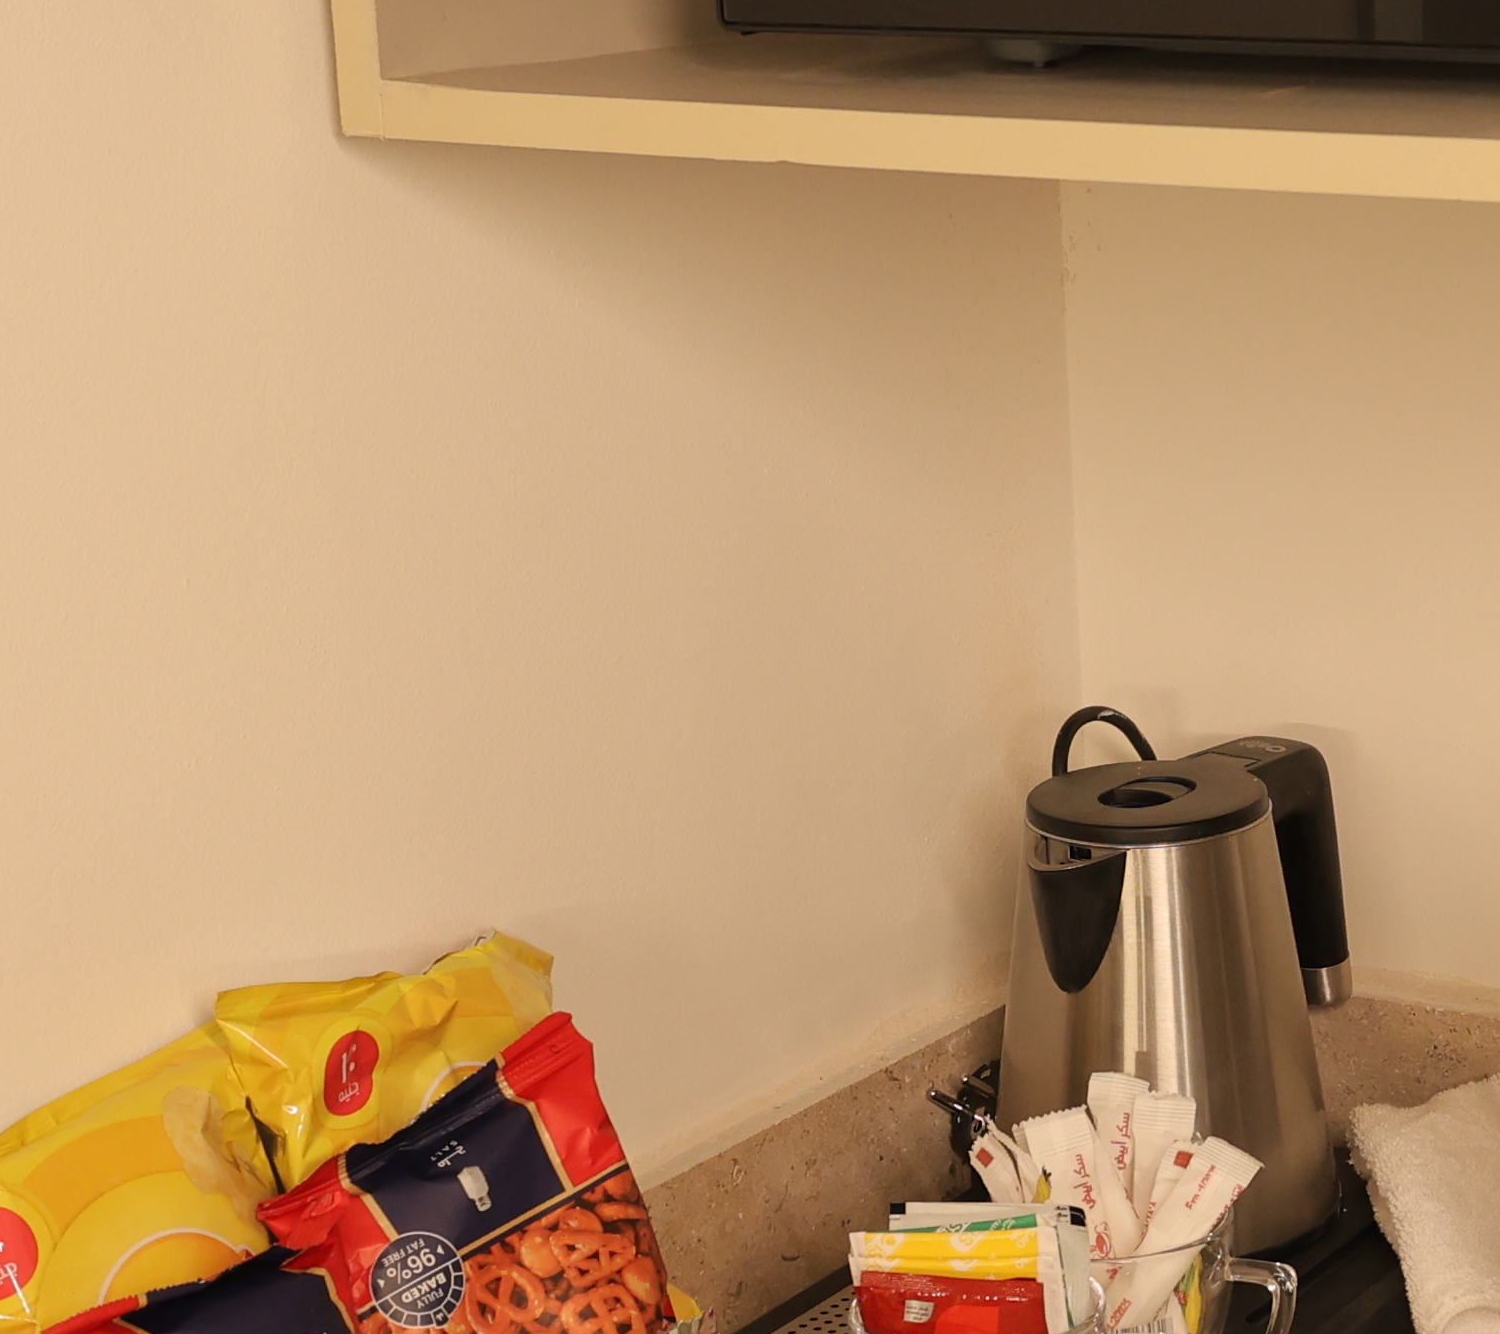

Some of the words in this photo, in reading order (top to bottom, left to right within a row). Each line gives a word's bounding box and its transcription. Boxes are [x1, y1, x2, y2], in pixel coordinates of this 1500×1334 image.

[403, 1237, 426, 1255] FAT
[382, 1250, 406, 1268] FREE
[386, 1247, 436, 1285] 96%
[401, 1271, 448, 1303] BAKED
[417, 1287, 445, 1309] FULLY
